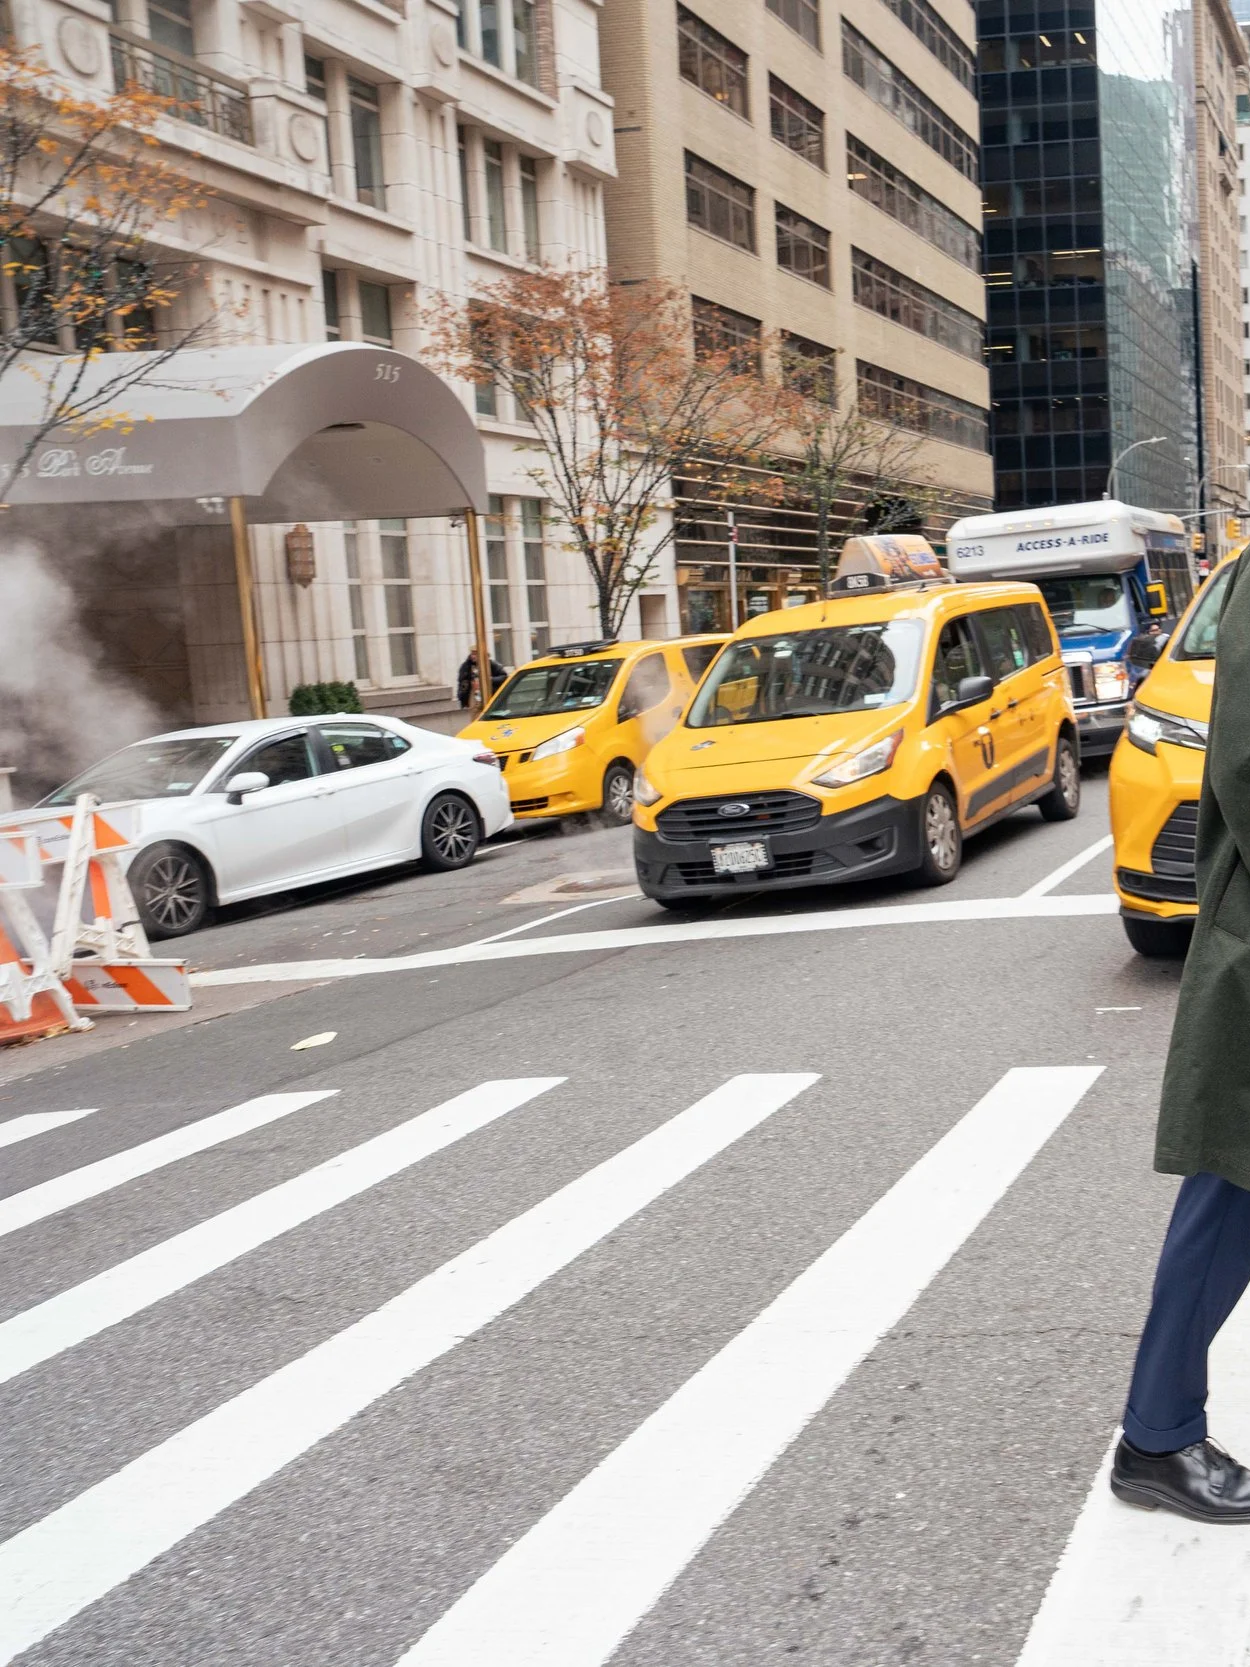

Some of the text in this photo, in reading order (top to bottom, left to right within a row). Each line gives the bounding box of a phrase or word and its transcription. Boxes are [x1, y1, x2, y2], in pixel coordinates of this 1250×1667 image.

[373, 363, 402, 383] 515
[956, 545, 985, 559] 6213
[1016, 532, 1109, 552] ACCESS-A-RIDE
